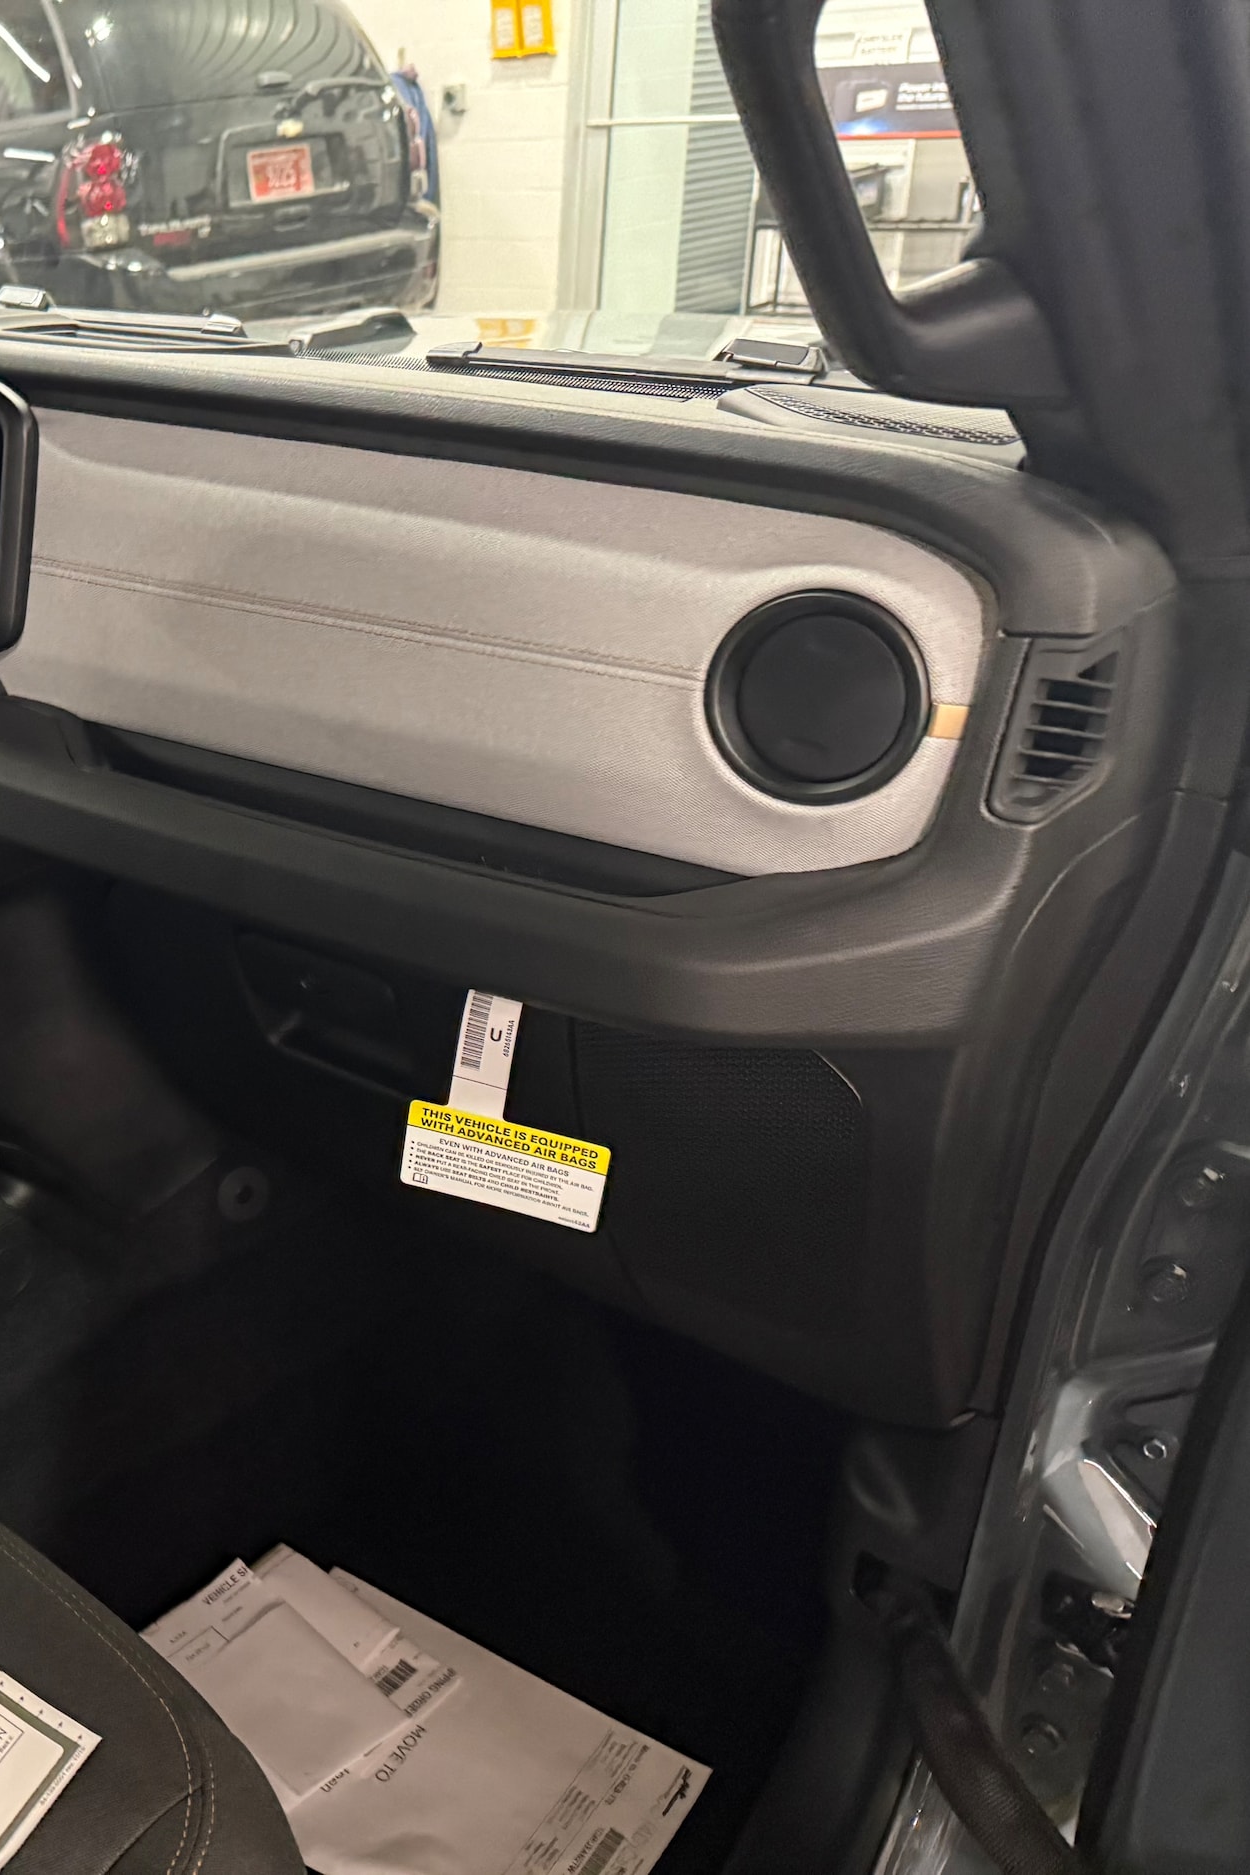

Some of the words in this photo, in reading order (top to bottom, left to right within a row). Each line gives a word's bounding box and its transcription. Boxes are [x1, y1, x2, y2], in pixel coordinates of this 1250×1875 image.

[489, 1027, 502, 1042] U
[420, 1117, 454, 1133] WITH
[457, 1126, 530, 1152] ADVANCED
[533, 1146, 557, 1158] AIR
[560, 1153, 597, 1169] BAGS
[421, 1107, 451, 1122] THIS
[454, 1115, 511, 1136] VEHICLE
[514, 1130, 527, 1140] IS
[530, 1134, 599, 1159] EQUIPPED
[415, 1154, 435, 1162] NEVER
[416, 1141, 444, 1152] CHILDREN
[465, 1154, 484, 1162] KILLED
[439, 1138, 460, 1148] EVEN
[461, 1143, 483, 1154] WITH
[484, 1149, 529, 1166] ADVANCED
[530, 1161, 545, 1170] AIR
[546, 1165, 569, 1176] BAGS
[414, 1160, 439, 1170] ALWAYS
[468, 1174, 486, 1182] BELTS
[499, 1182, 519, 1191] CHILD
[478, 1164, 500, 1173] SAFEST
[502, 1170, 519, 1178] PLACE
[201, 1572, 240, 1607] VEHICLE
[387, 1722, 429, 1766] MOVE
[373, 1760, 397, 1785] TO
